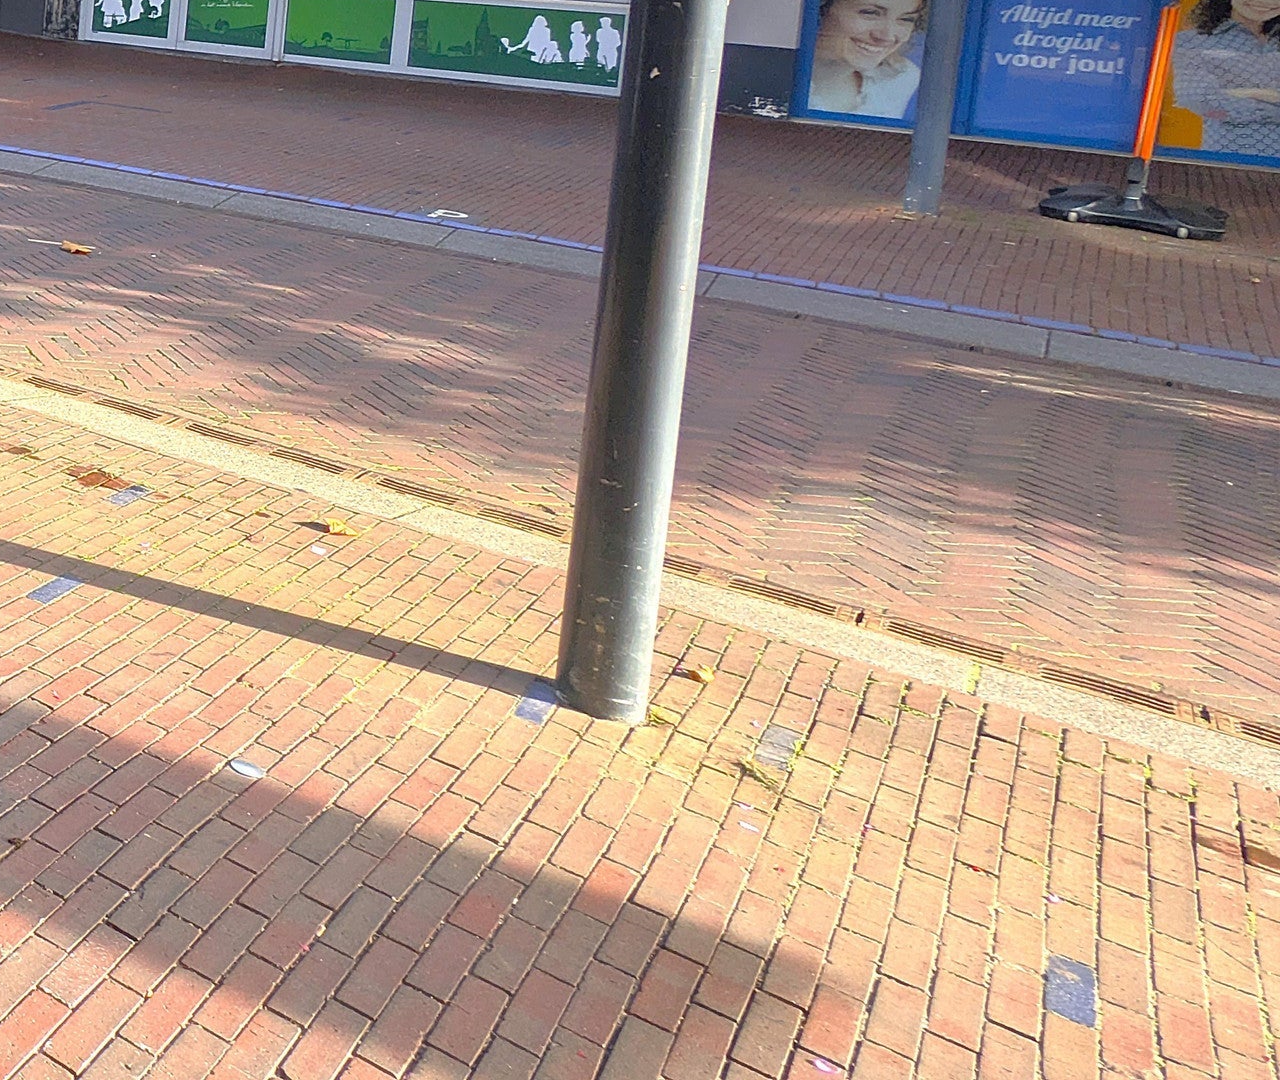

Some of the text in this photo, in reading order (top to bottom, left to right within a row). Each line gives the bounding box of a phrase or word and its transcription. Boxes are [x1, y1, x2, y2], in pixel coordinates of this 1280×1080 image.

[1000, 4, 1142, 29] Altijd meer
[1013, 30, 1105, 54] drogist
[995, 52, 1126, 75] voor jou!
